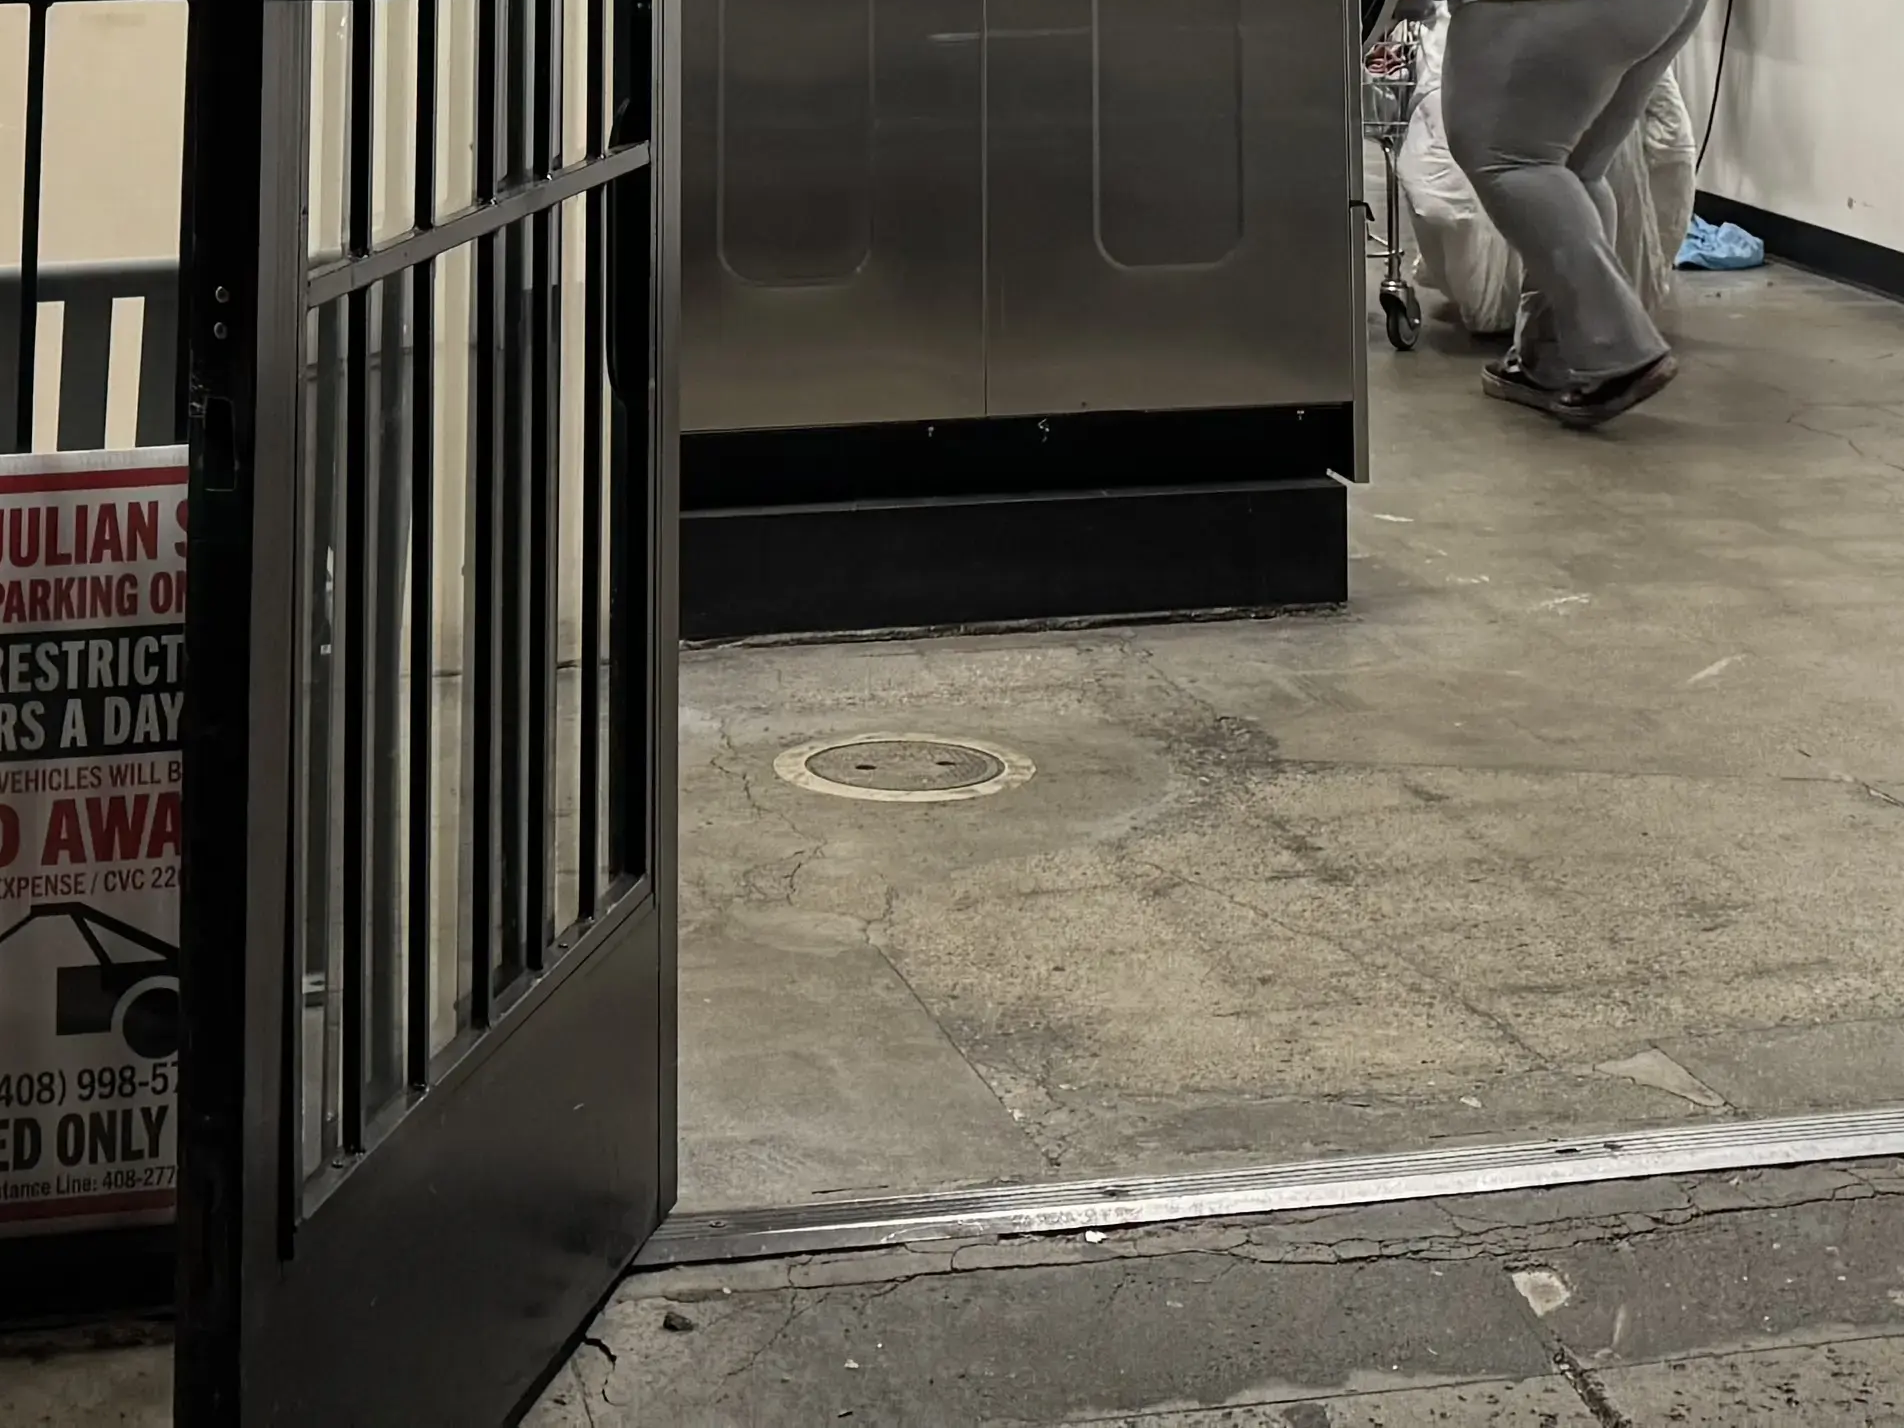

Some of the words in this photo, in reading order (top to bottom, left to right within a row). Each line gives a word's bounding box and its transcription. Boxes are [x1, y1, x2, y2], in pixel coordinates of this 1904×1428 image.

[59, 697, 88, 749] A
[103, 690, 185, 746] DAY
[109, 762, 161, 787] WILL
[103, 867, 145, 893] CVC
[57, 1105, 169, 1167] ONLY
[56, 1172, 98, 1194] Line:
